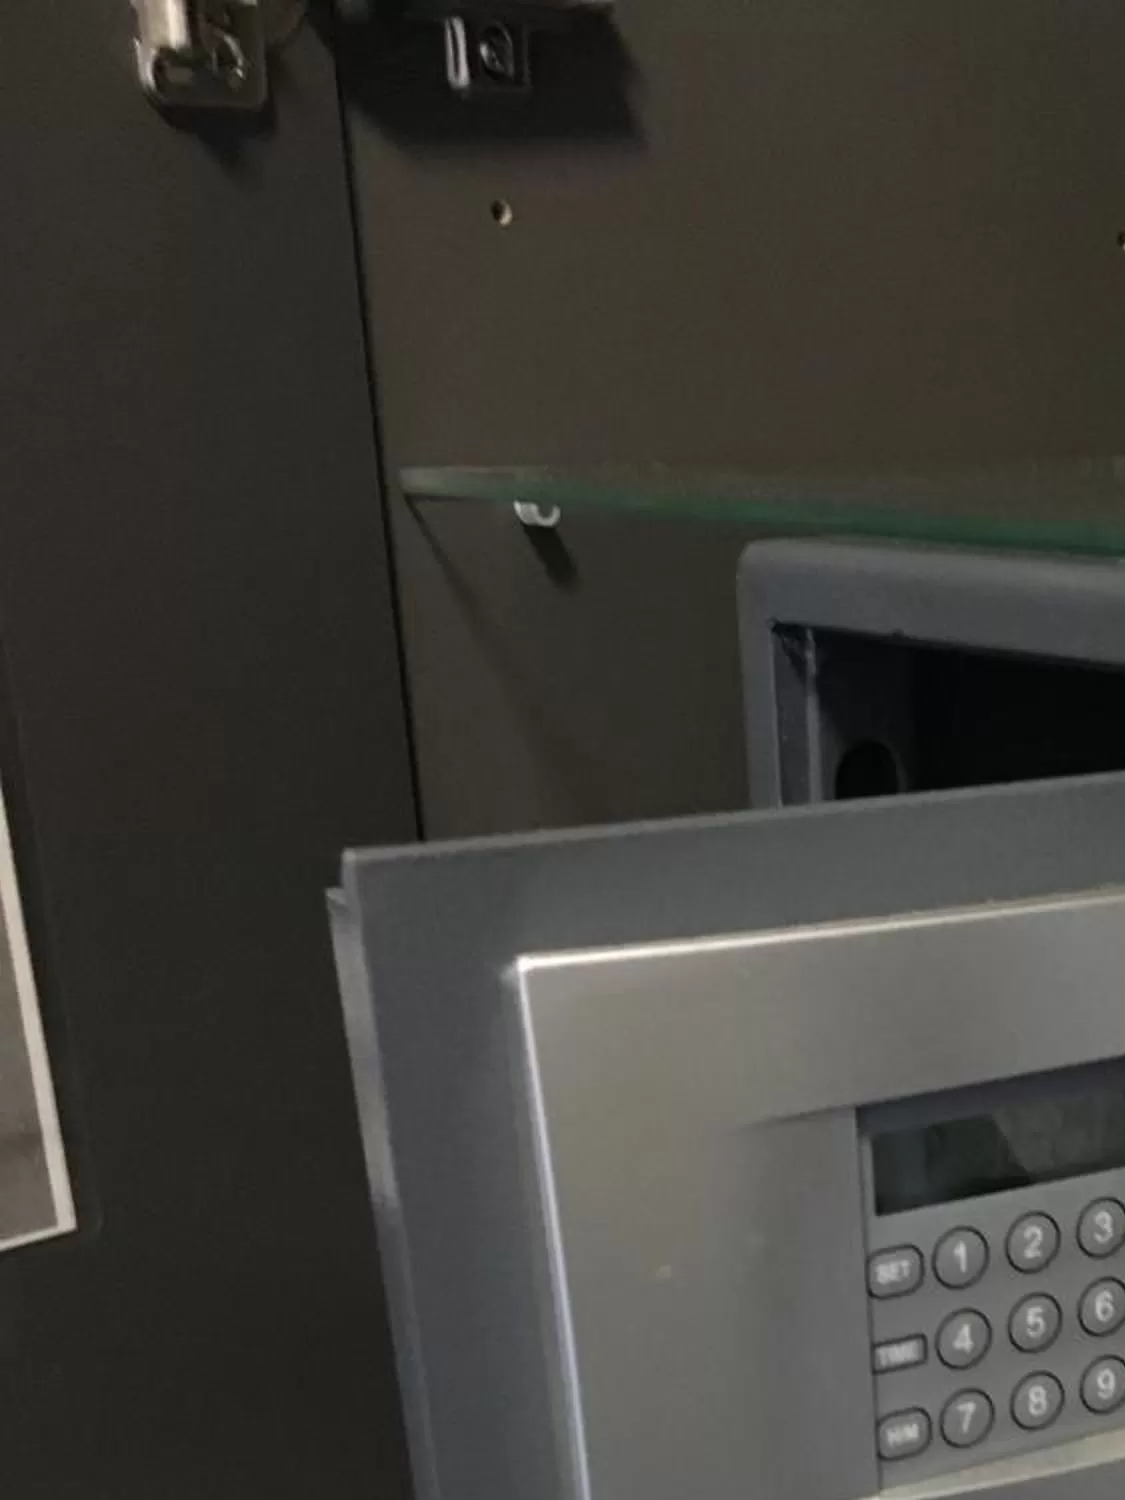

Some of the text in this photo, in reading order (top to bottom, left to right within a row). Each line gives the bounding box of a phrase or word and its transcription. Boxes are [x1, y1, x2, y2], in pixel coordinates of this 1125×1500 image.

[954, 1241, 969, 1274] 1
[1022, 1228, 1045, 1260] 2
[1094, 1212, 1114, 1244] 3
[953, 1324, 974, 1354] 4
[1026, 1306, 1046, 1337] 5
[1095, 1291, 1115, 1322] 6
[957, 1401, 976, 1433] 7
[1028, 1385, 1048, 1417] 8
[1096, 1369, 1115, 1400] 9
